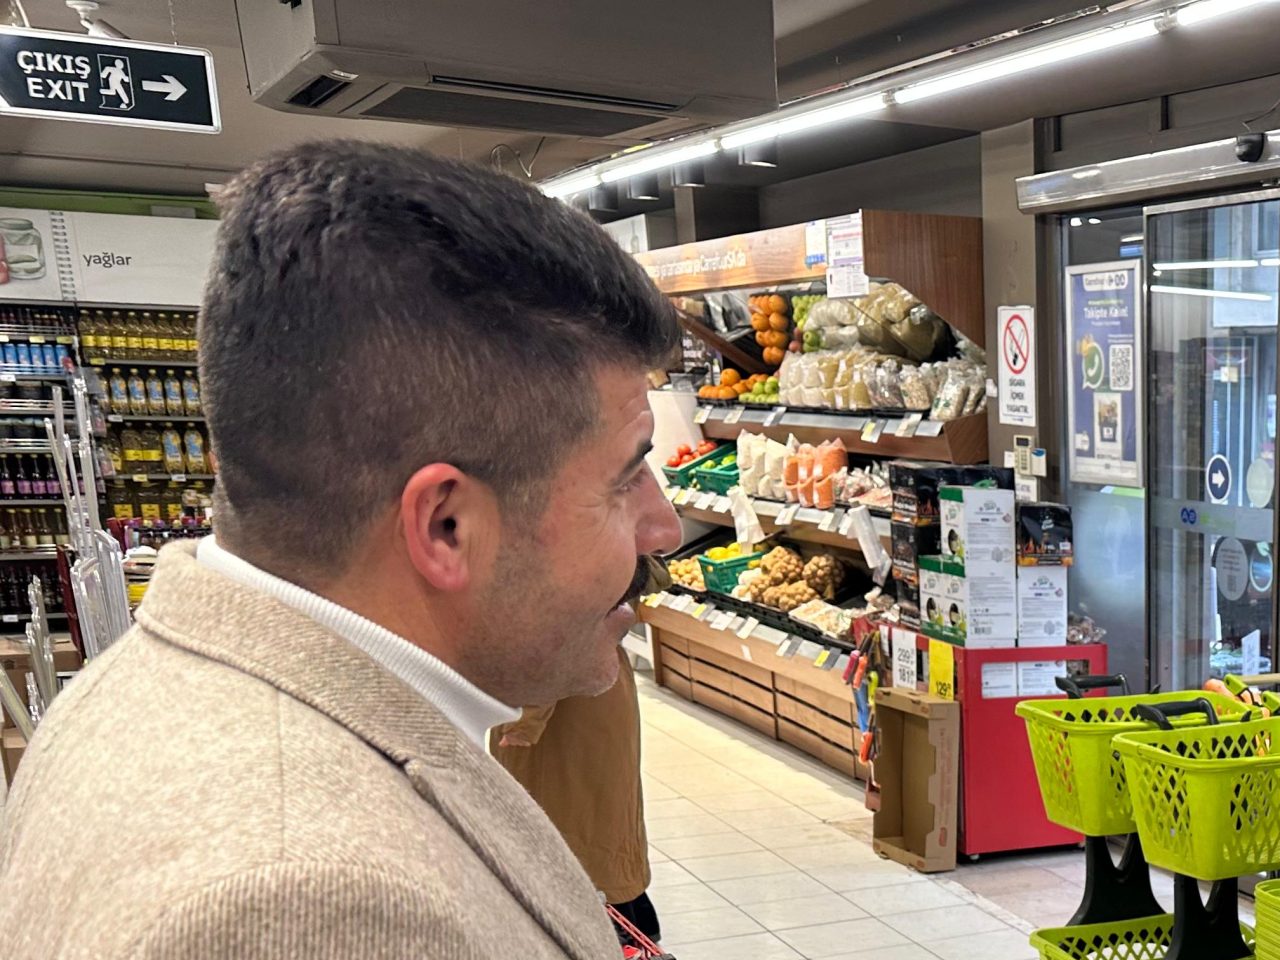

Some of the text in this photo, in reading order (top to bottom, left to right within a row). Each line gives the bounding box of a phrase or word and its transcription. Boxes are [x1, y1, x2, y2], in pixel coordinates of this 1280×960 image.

[17, 50, 91, 79] ÇIKIŞ
[26, 77, 89, 102] EXIT
[83, 251, 132, 268] yağlar
